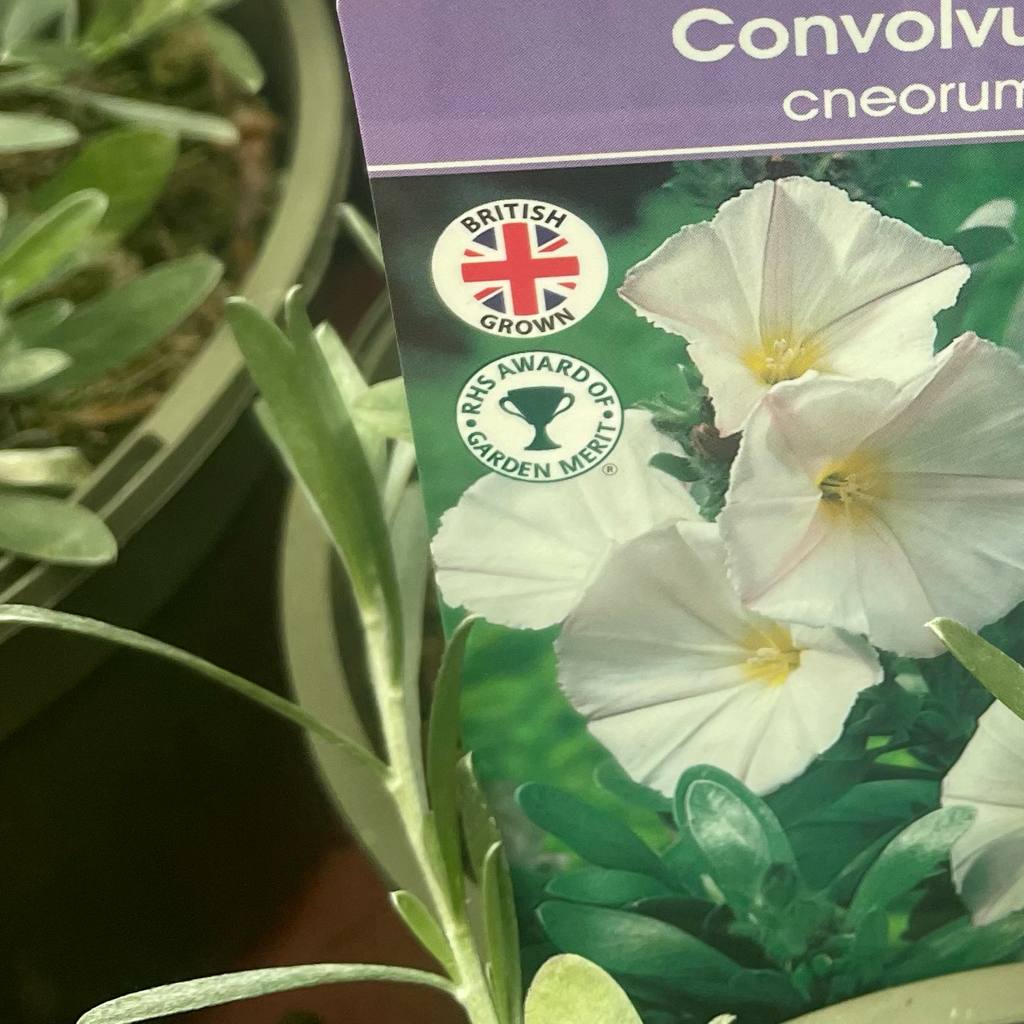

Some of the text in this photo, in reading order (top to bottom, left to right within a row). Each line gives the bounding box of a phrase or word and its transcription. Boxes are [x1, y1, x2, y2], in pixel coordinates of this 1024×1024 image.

[460, 203, 567, 234] BRITISH
[480, 307, 576, 335] GROWN
[462, 355, 614, 415] RHS AWARD OF
[467, 421, 616, 479] GARDEN MERIT
